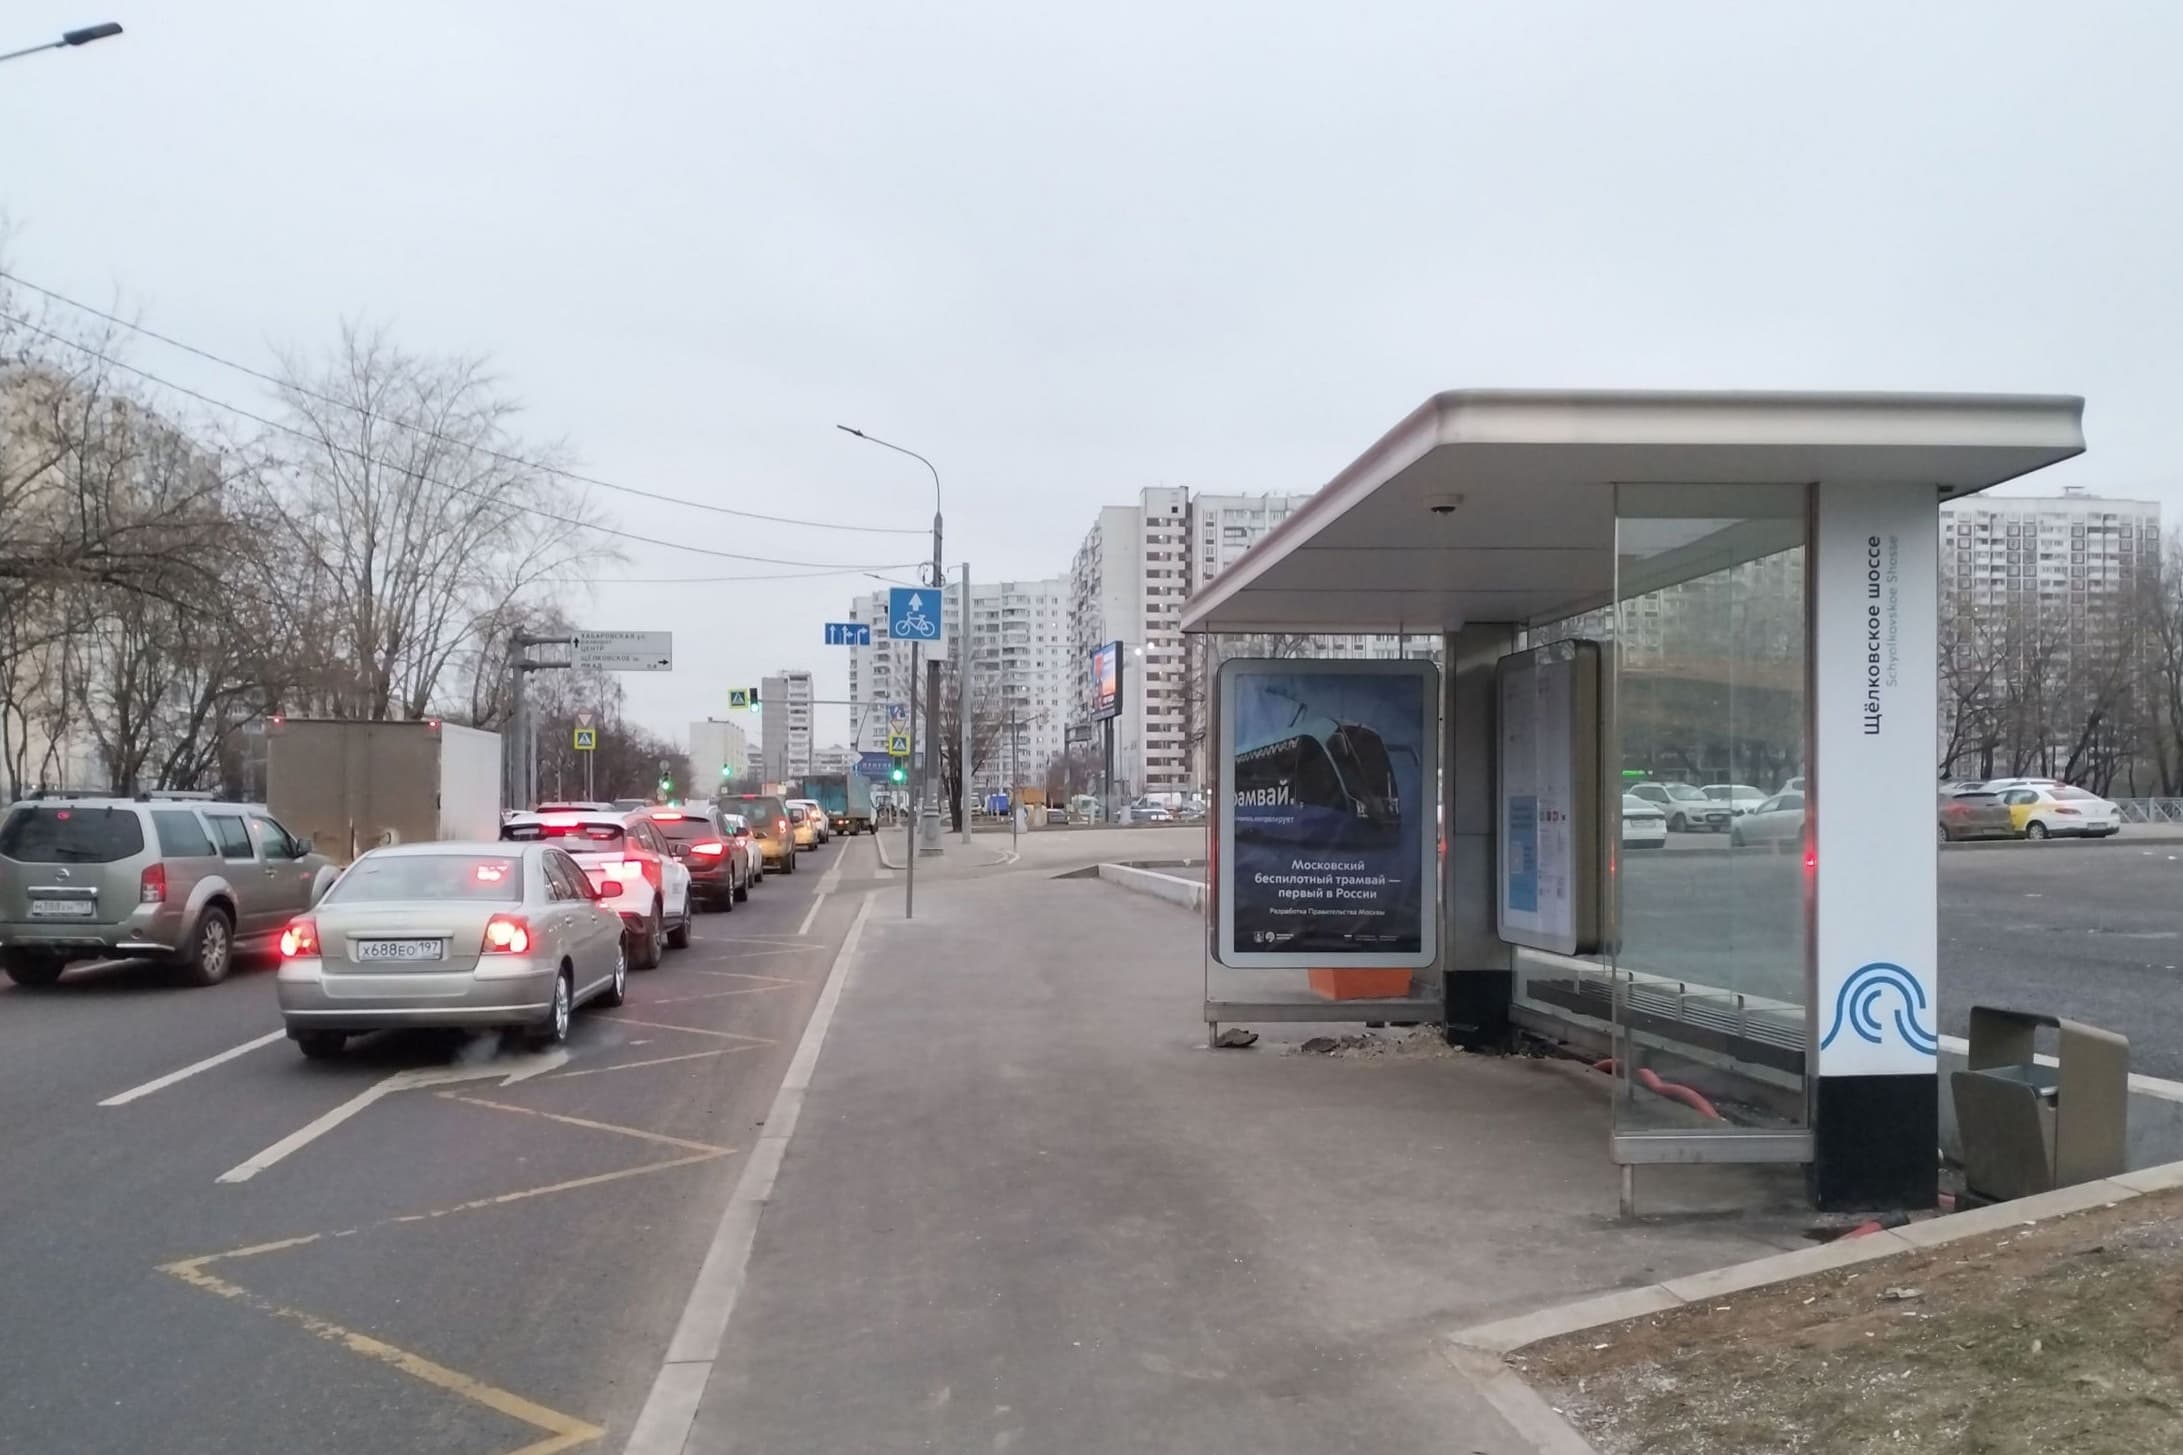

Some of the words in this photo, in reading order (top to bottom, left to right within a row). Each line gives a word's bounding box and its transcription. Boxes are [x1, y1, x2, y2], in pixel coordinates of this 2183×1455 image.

[1868, 536, 1881, 599] шоссе
[1886, 536, 1898, 583] Shosse
[1886, 590, 1899, 687] Schyolkovskoe
[1864, 605, 1882, 735] Щёлковское
[1254, 872, 1333, 885] беспилотный
[1335, 875, 1386, 886] трамвай
[1291, 859, 1365, 871] Московский
[1278, 888, 1323, 899] первый
[1326, 890, 1333, 898] в
[1336, 888, 1377, 899] России
